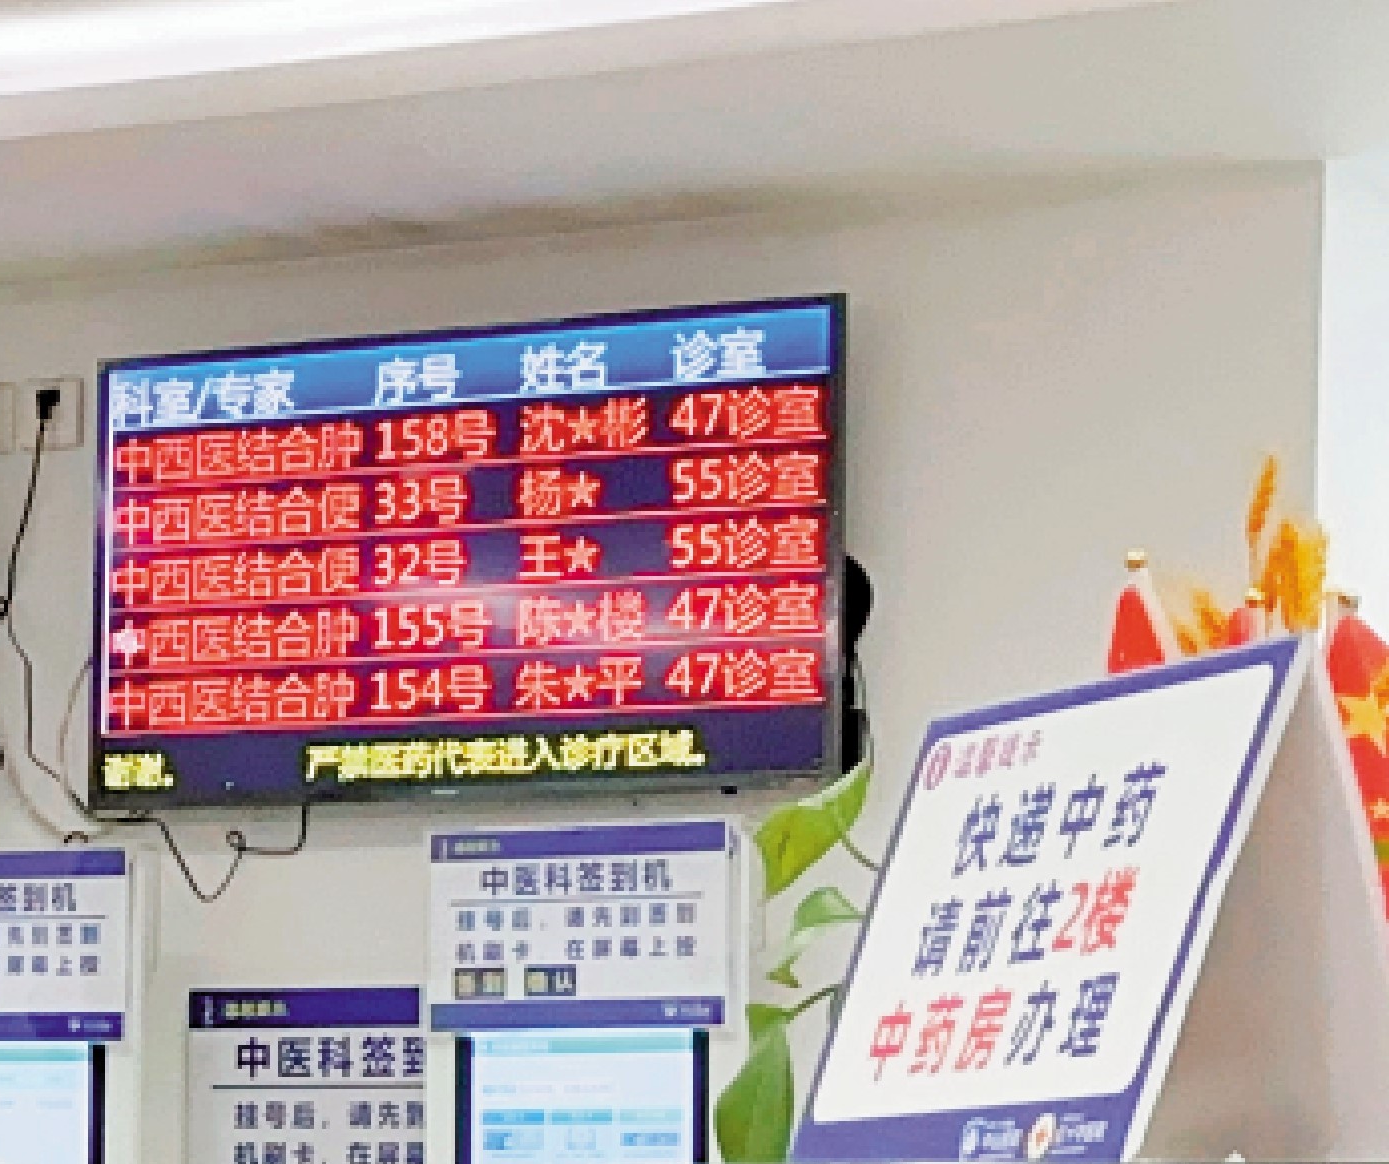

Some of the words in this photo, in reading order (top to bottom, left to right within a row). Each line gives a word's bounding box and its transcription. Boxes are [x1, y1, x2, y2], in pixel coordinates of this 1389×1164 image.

[115, 369, 294, 421] 科室/专家
[375, 354, 460, 404] 序号
[521, 342, 607, 391] 姓名
[672, 329, 766, 379] 诊室
[118, 430, 360, 479] 中西医结合肿
[377, 409, 497, 461] 158号
[672, 385, 819, 436] 47诊室
[118, 483, 360, 544] 中西医结合便
[376, 474, 468, 522] 33号
[671, 454, 819, 502] 55诊室
[118, 549, 360, 604] 中西医结合便
[376, 538, 468, 585] 32号
[670, 522, 819, 571] 55诊室
[115, 612, 359, 666] 中西医结合肿
[372, 599, 490, 648] 155号
[666, 582, 819, 634] 47诊室
[112, 677, 354, 727] 中西医结合肿
[370, 662, 489, 711] 154号
[665, 647, 819, 699] 47诊室
[952, 761, 1167, 877] 快递中药
[479, 859, 673, 896] 中医科签到机
[913, 867, 1138, 977] 请前往2楼
[870, 972, 1119, 1081] 中药房办理
